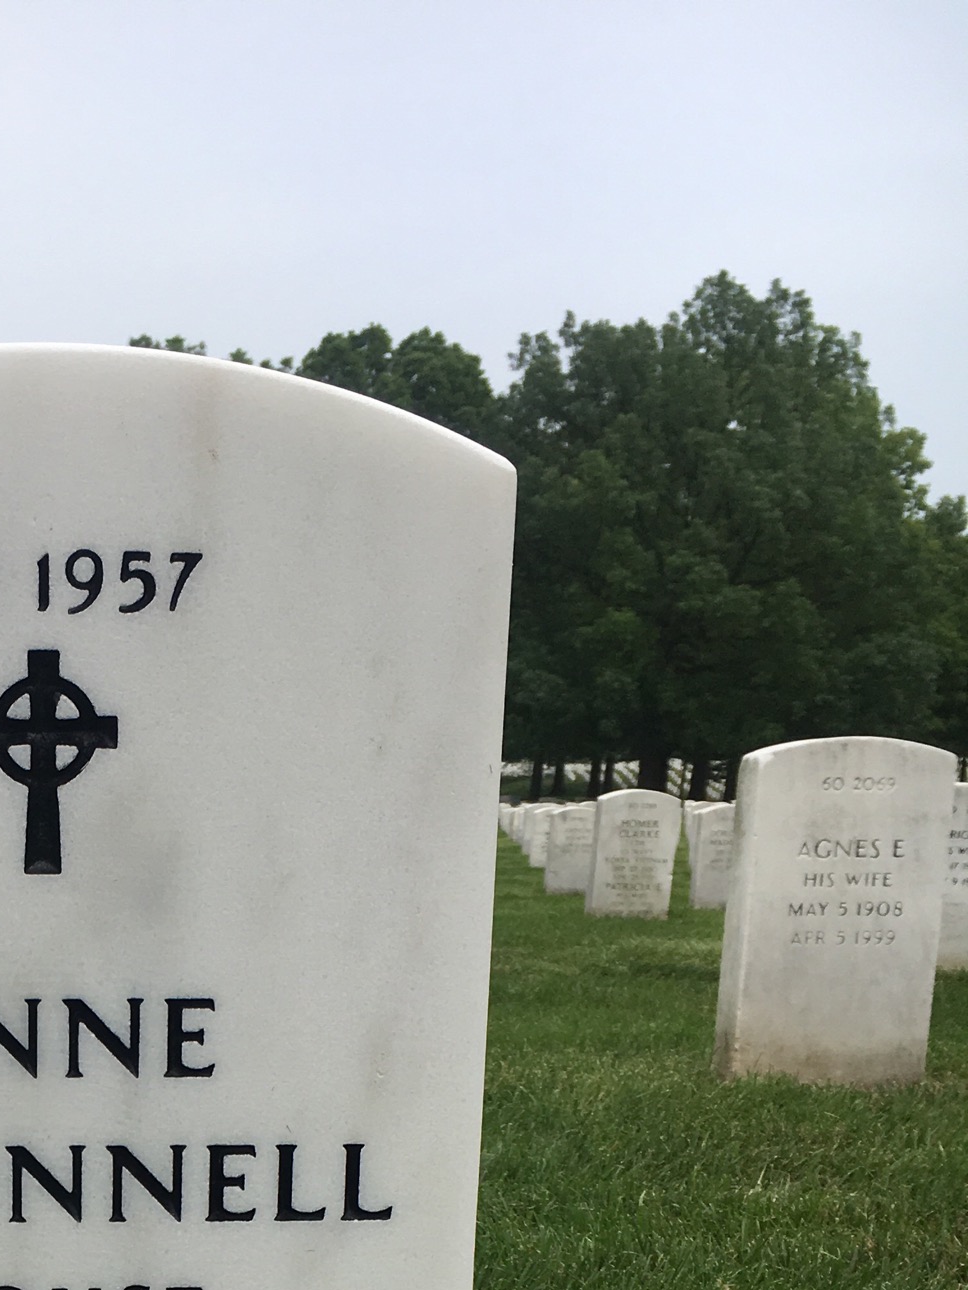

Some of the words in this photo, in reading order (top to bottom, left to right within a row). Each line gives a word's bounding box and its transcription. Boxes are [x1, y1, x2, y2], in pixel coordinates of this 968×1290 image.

[36, 548, 205, 615] 1957
[822, 776, 845, 791] 60
[798, 838, 881, 859] AGNES
[893, 839, 905, 858] E
[803, 872, 835, 887] HIS
[845, 872, 893, 887] WIFE
[788, 902, 829, 916] MAY
[838, 902, 848, 916] 5
[856, 901, 903, 917] 1908
[790, 931, 825, 945] APR
[836, 930, 846, 945] 5
[854, 930, 896, 946] 1999
